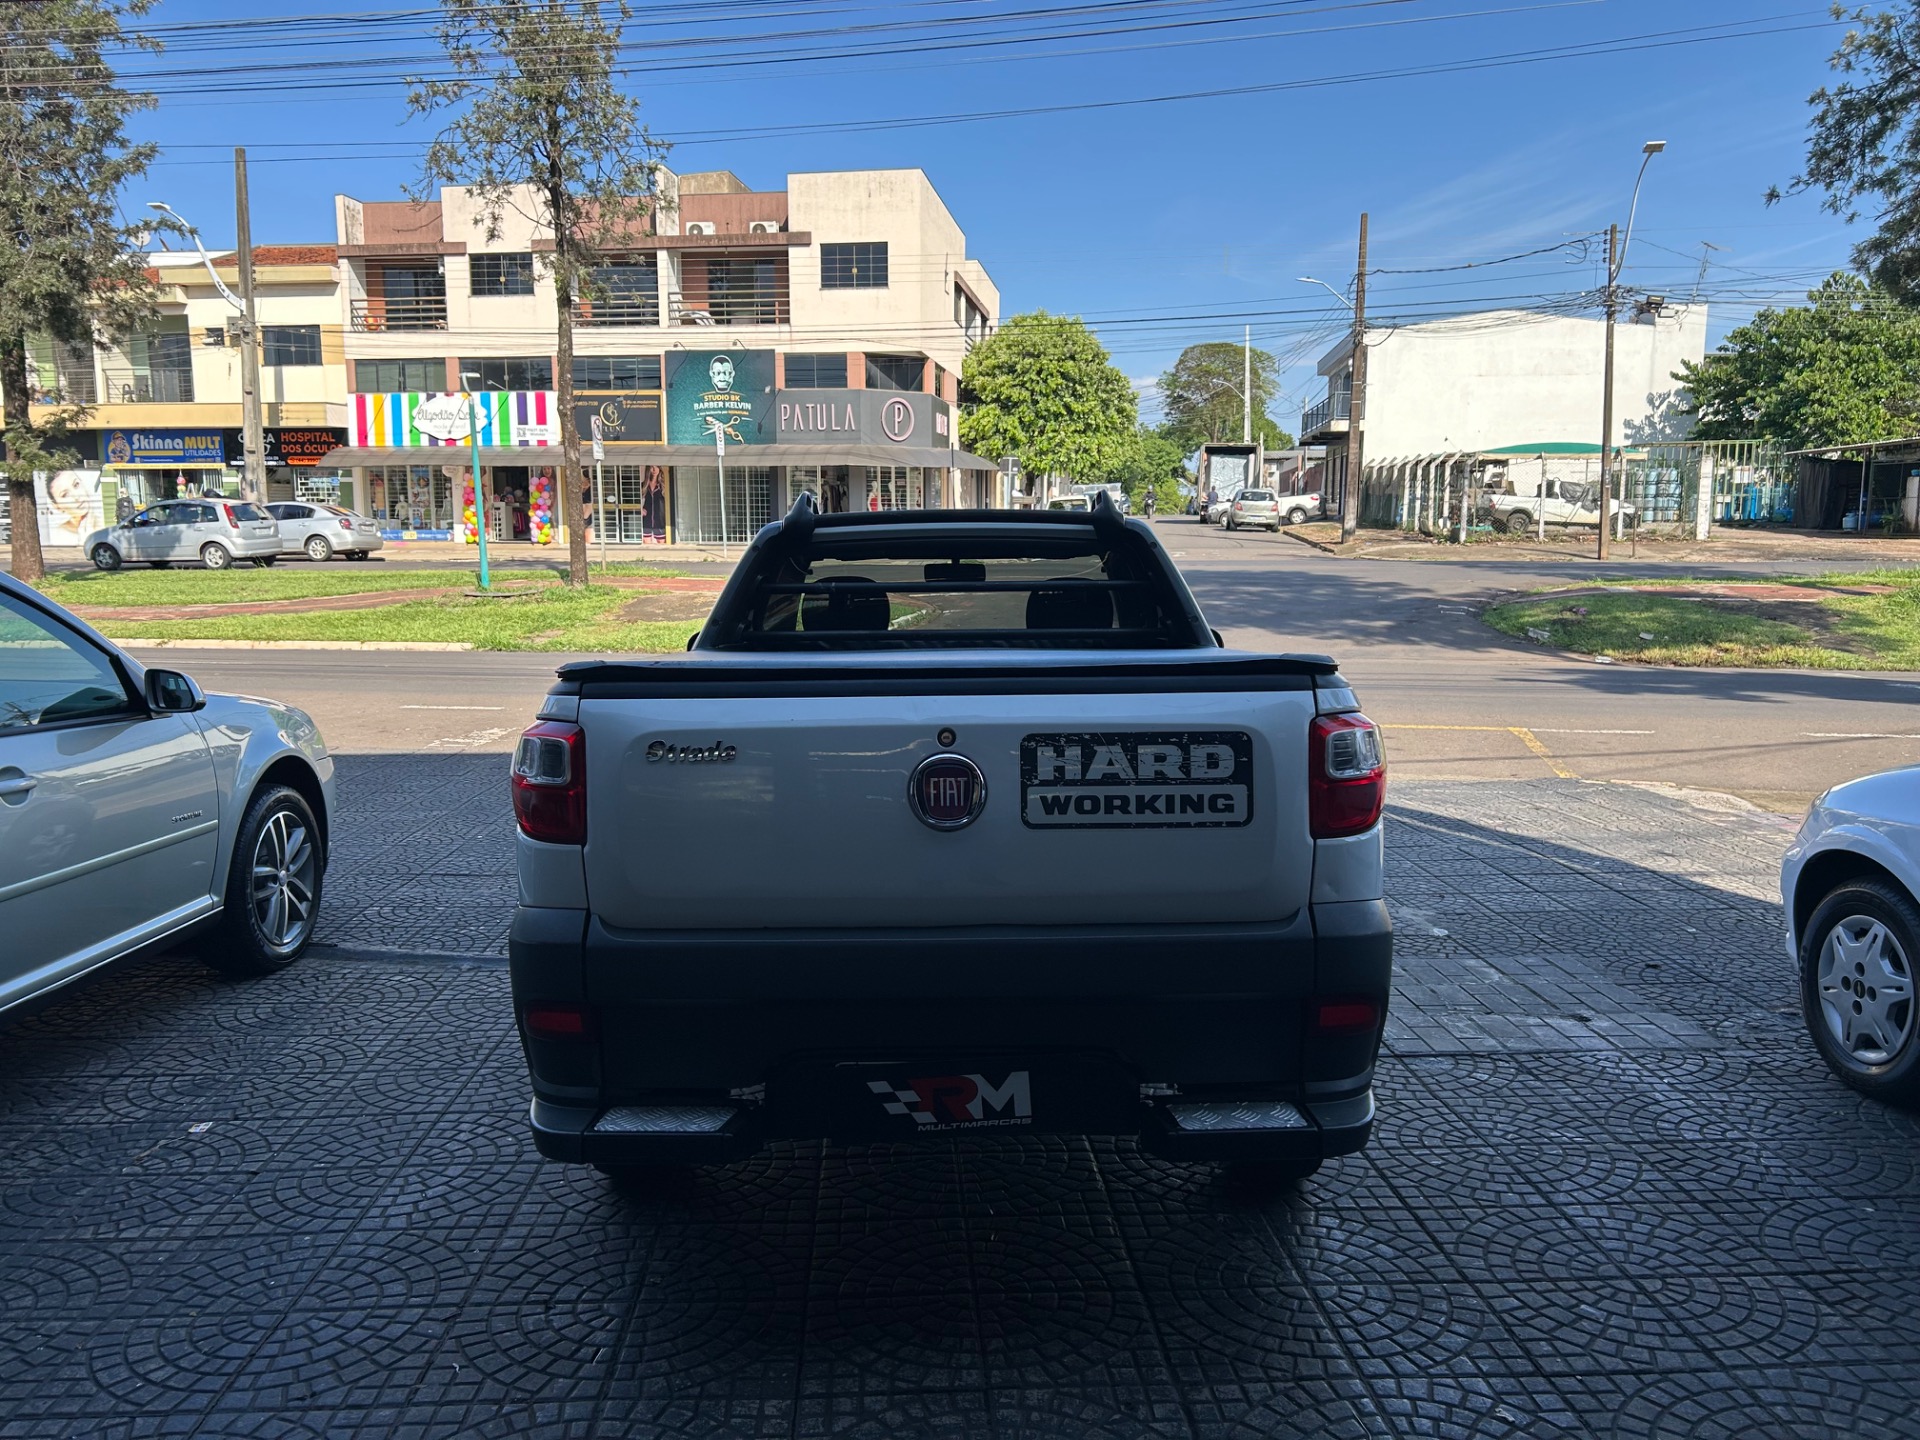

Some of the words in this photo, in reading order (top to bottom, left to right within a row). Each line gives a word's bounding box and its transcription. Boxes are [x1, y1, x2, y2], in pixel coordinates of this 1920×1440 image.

[693, 402, 724, 411] BARBER
[725, 401, 752, 410] KELVIN
[704, 394, 730, 402] STUDIO
[730, 394, 741, 402] BK
[781, 403, 856, 431] PATULA
[894, 404, 904, 434] P
[280, 431, 336, 443] HOSPITAL
[281, 444, 302, 453] DOS
[303, 442, 343, 454] ÓCULO
[185, 449, 222, 457] UTILIDADES
[645, 740, 737, 762] Strada
[1036, 744, 1236, 781] HARD
[929, 777, 969, 808] FIAT
[1038, 793, 1236, 816] WORKING
[908, 1071, 1033, 1121] RM
[917, 1117, 1033, 1132] MULTIMARCAS
